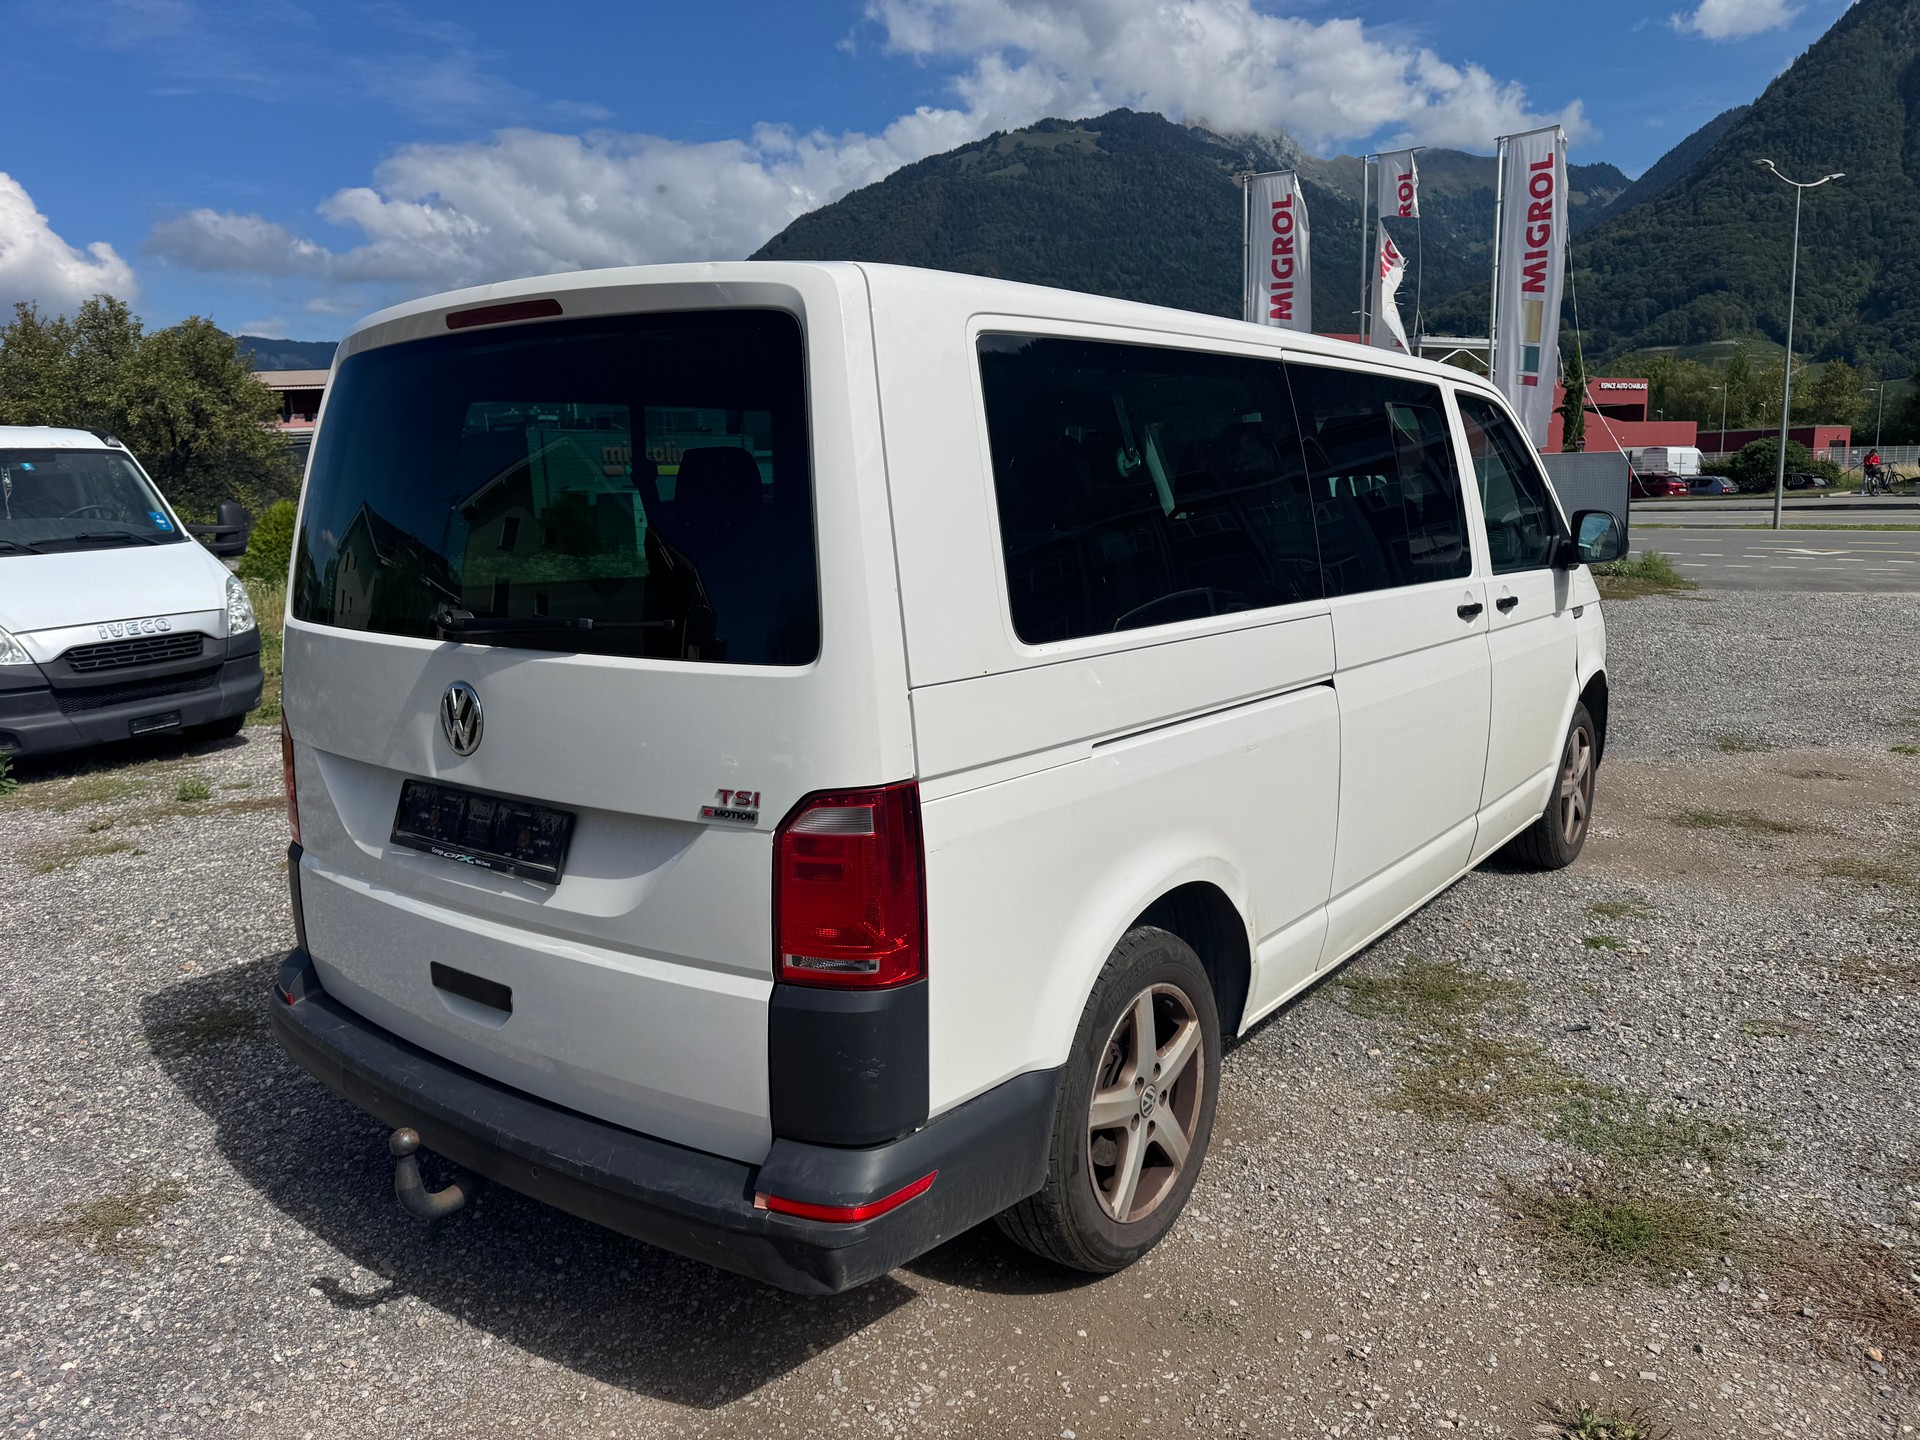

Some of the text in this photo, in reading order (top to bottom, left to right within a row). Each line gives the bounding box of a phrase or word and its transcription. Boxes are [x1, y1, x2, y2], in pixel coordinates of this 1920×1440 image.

[1270, 193, 1295, 320] MIGROL
[1522, 153, 1554, 293] MIGROL
[97, 618, 172, 639] IVECO
[716, 789, 760, 808] TSI
